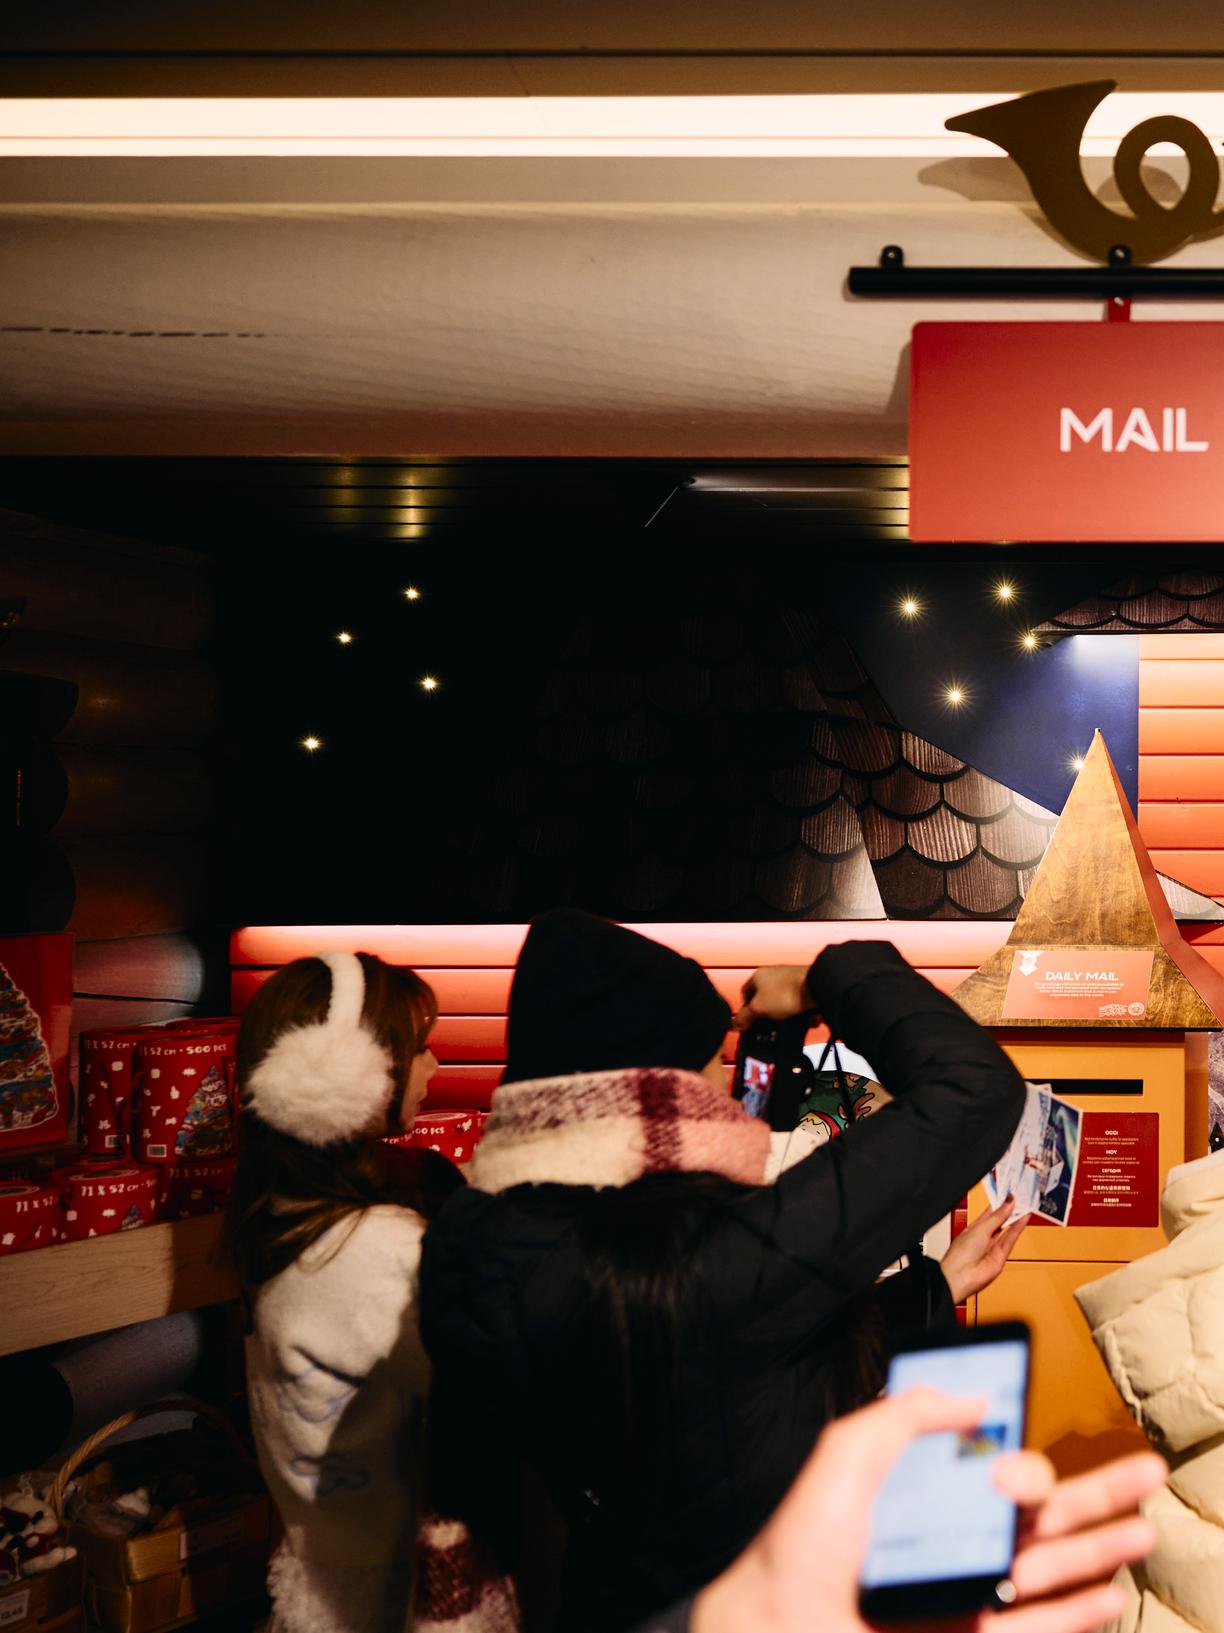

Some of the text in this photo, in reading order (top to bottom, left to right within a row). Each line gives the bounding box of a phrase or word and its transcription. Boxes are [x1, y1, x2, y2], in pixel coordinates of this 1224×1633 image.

[1059, 407, 1209, 452] MAIL
[1045, 971, 1120, 981] DAILY MAIL
[185, 1045, 211, 1055] 500
[81, 1185, 94, 1197] 71
[109, 1183, 125, 1195] 52
[15, 1201, 29, 1214] 71
